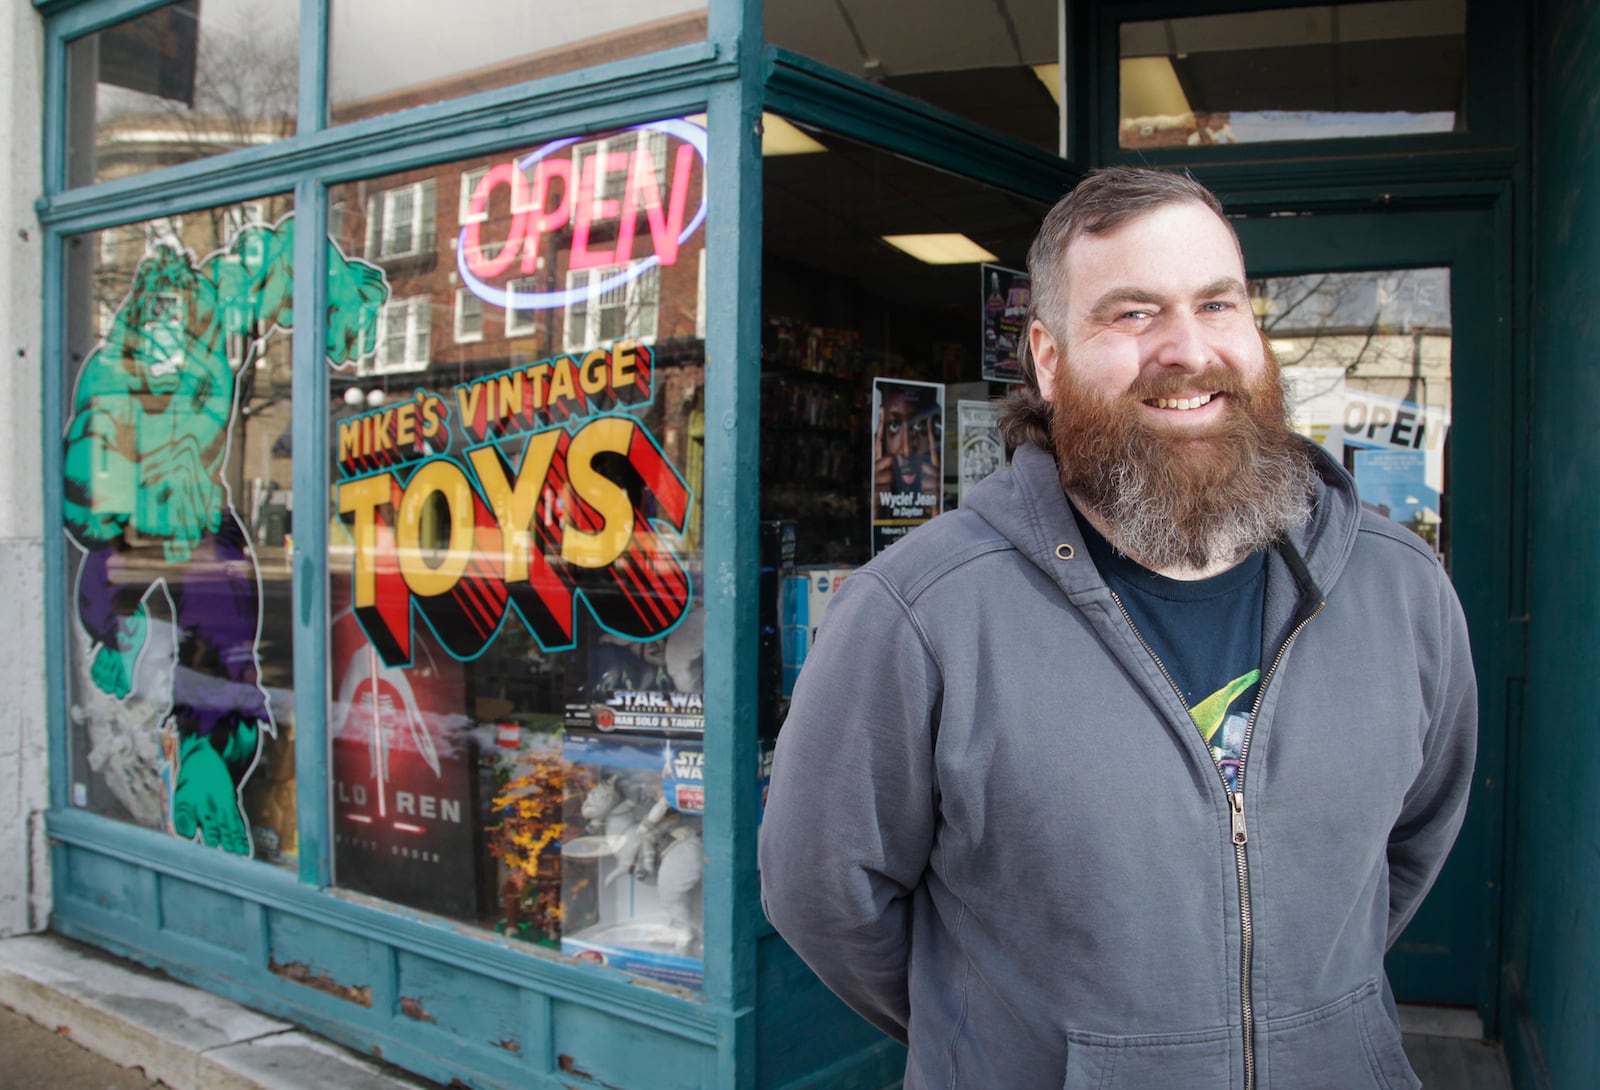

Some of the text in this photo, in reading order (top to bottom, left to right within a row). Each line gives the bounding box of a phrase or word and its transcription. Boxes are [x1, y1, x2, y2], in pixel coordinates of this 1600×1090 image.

[464, 144, 694, 278] OPEN
[339, 338, 637, 463] MIKE'S VINTAGE
[1344, 402, 1441, 451] OPEN
[338, 416, 638, 609] TOYS
[880, 492, 937, 509] Wyclef Jean
[606, 690, 666, 707] STAR
[636, 717, 658, 728] SOLO
[396, 791, 461, 823] REN
